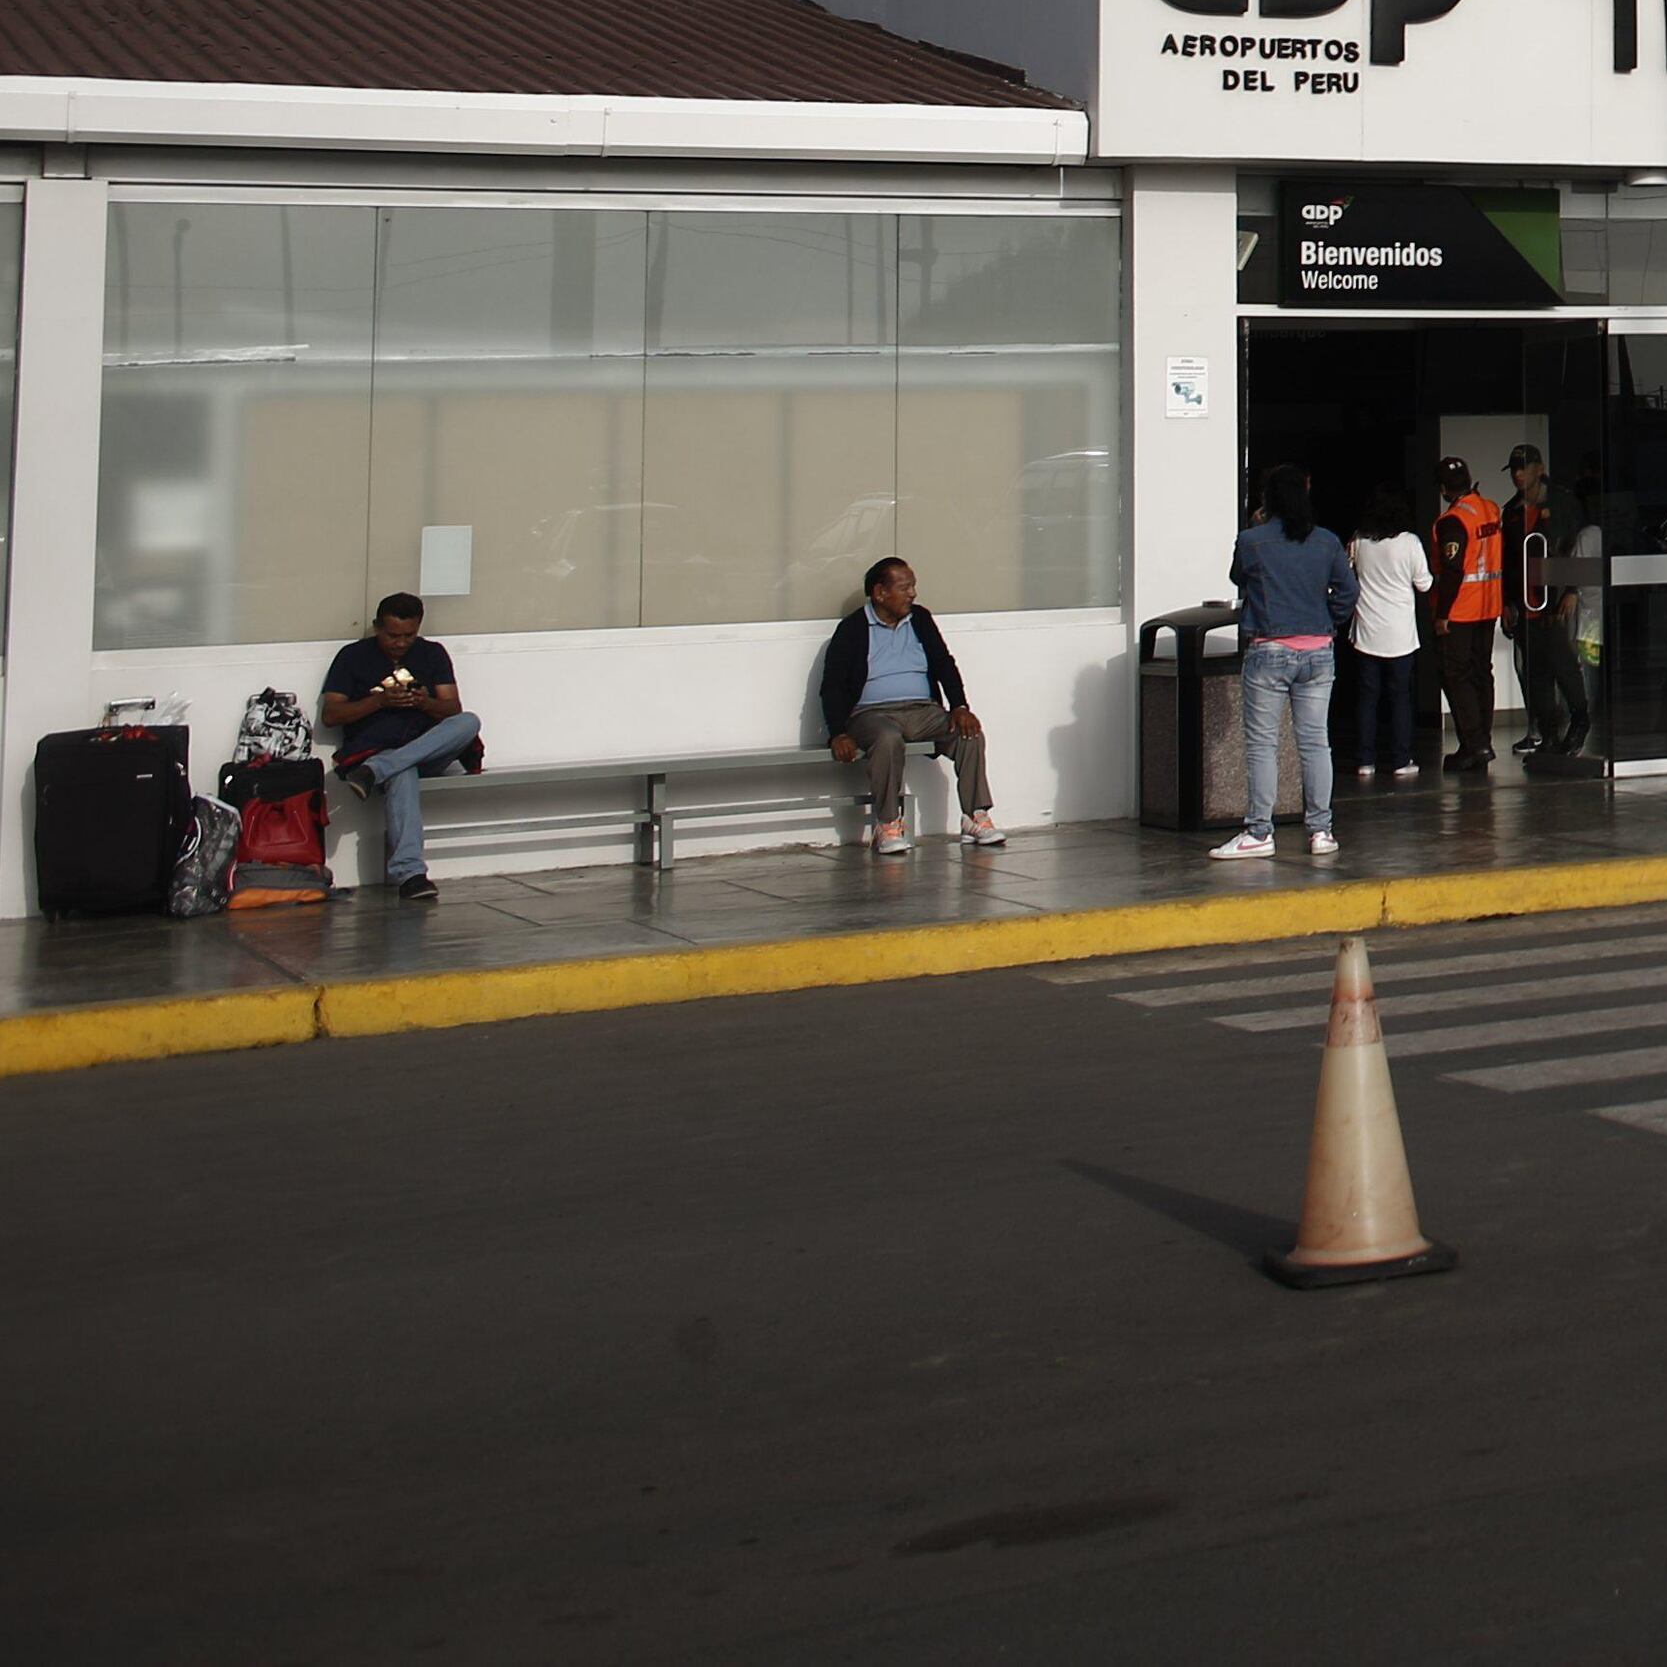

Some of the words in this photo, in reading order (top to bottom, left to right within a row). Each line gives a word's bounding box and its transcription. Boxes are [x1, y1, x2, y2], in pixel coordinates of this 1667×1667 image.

[1161, 33, 1360, 64] AEROPUERTOS
[1222, 69, 1275, 92] DEL
[1294, 71, 1359, 95] PERU
[1300, 241, 1443, 267] Bienvenidos
[1301, 271, 1379, 290] Welcome
